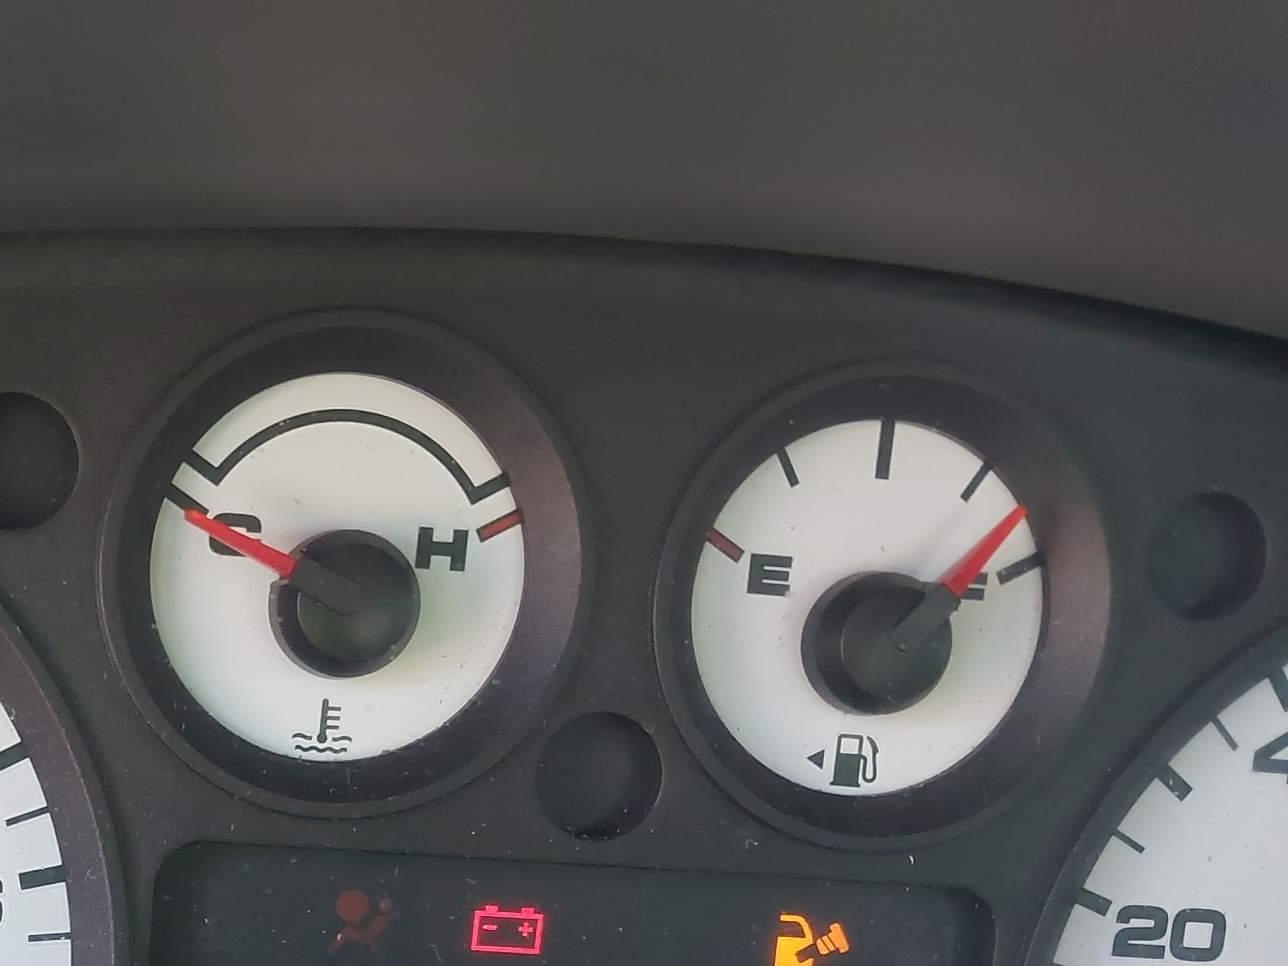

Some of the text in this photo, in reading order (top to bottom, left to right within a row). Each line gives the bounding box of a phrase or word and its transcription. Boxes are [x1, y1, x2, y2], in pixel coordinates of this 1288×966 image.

[414, 526, 469, 572] H
[746, 552, 793, 597] E
[1111, 904, 1227, 962] 20
